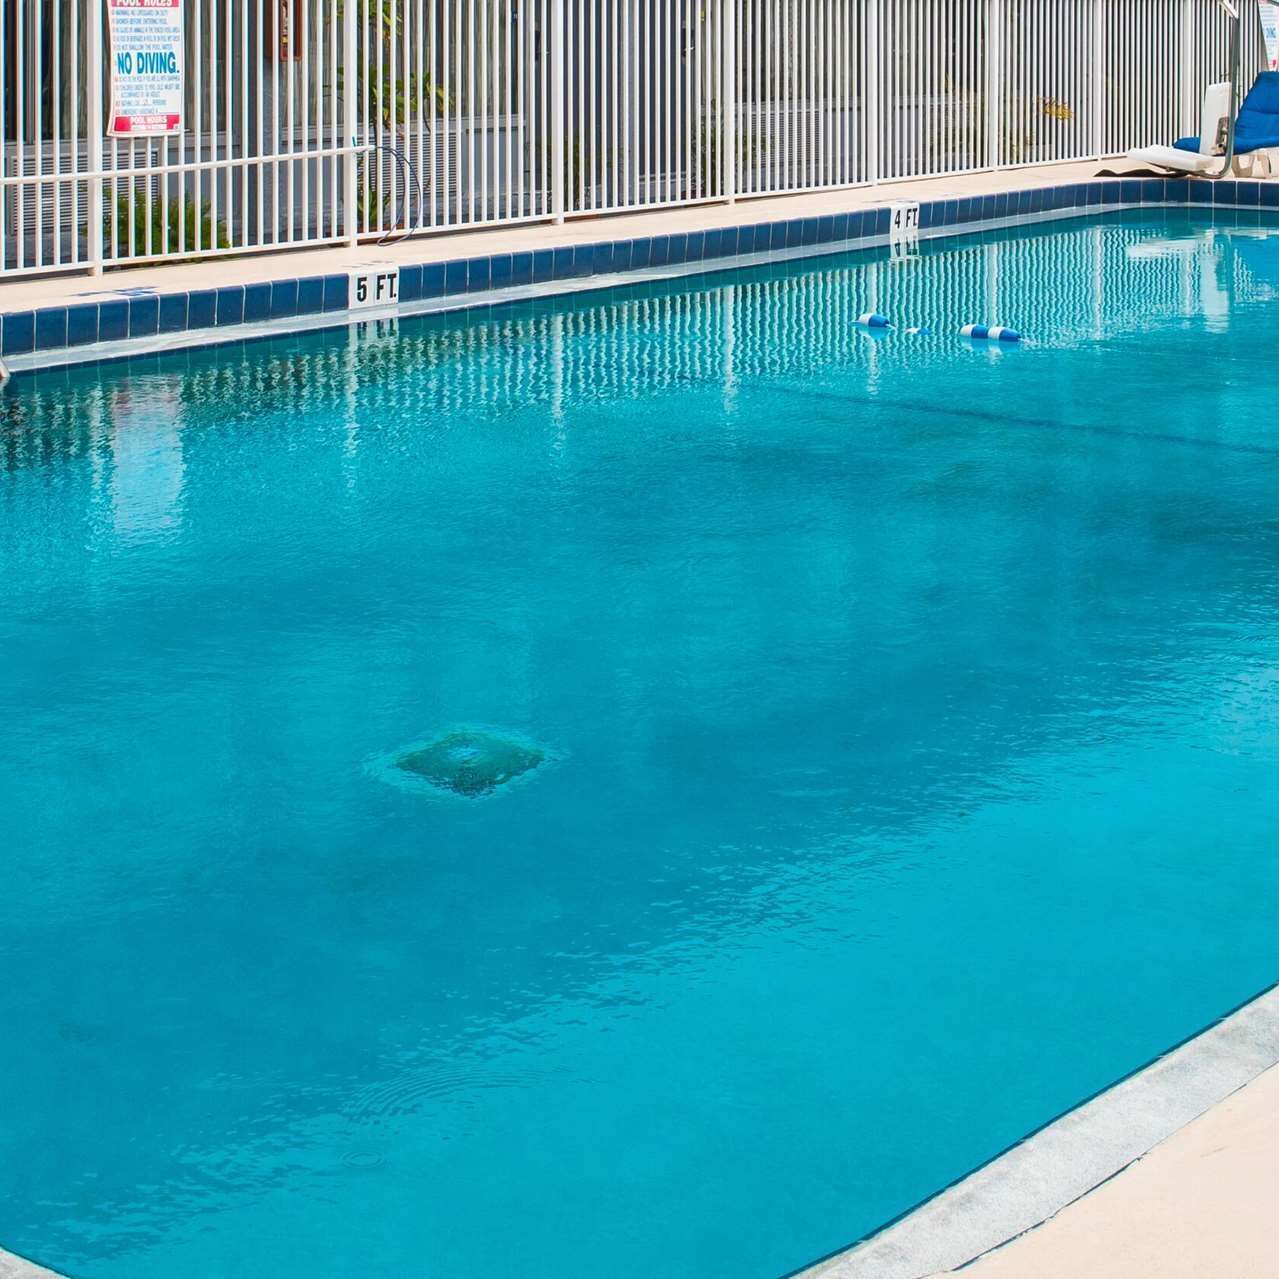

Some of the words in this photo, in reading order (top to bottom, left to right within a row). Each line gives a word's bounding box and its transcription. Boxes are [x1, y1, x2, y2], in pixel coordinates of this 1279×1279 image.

[117, 51, 132, 75] NO
[136, 51, 180, 74] DIVING.
[894, 209, 901, 229] 4
[357, 276, 368, 303] 5
[375, 272, 397, 301] FT.
